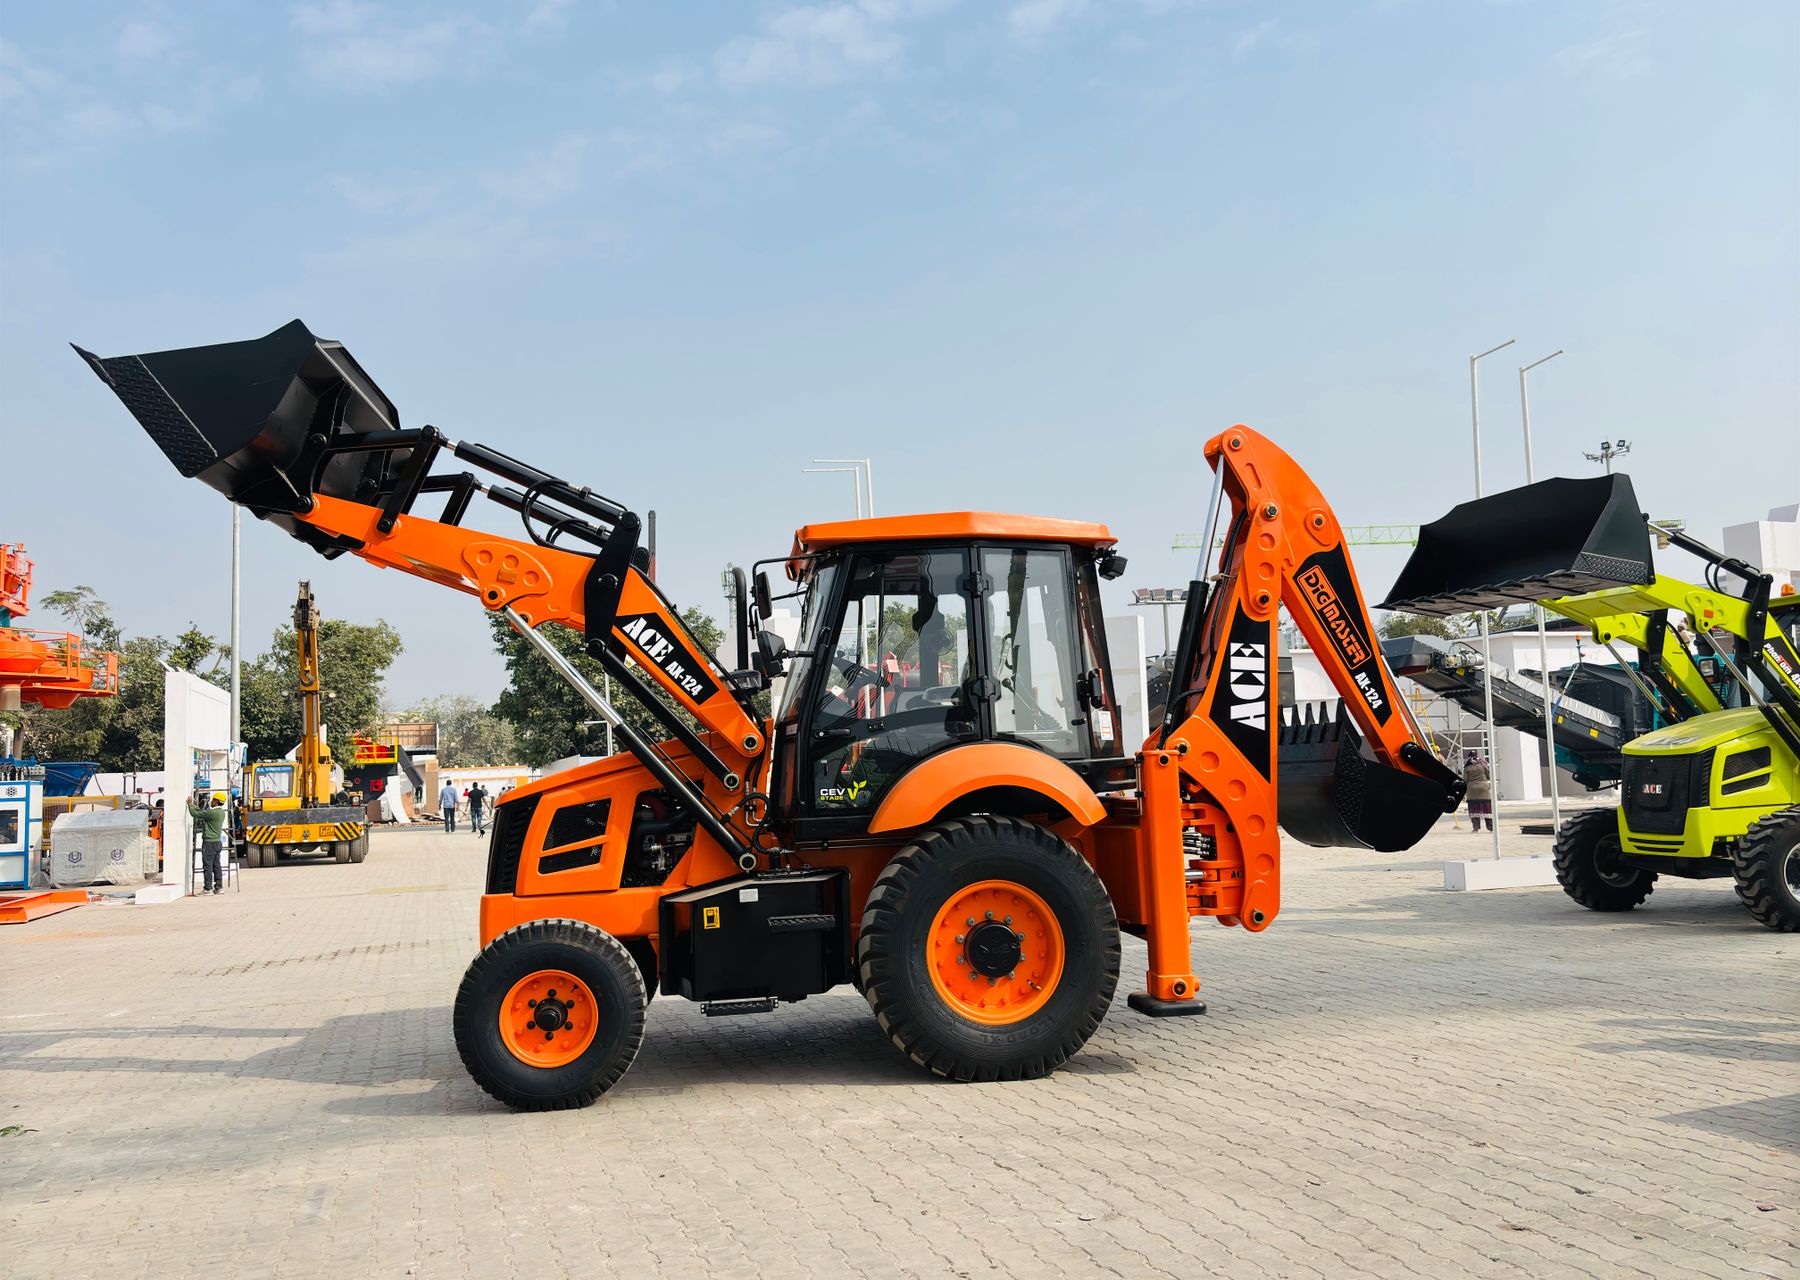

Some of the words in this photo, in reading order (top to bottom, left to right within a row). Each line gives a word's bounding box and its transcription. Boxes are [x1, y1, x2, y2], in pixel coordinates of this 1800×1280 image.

[622, 617, 674, 663] ACE
[665, 661, 703, 696] AX-124
[1230, 642, 1265, 731] ACE
[1354, 671, 1383, 710] AX-124
[820, 788, 845, 796] CEV
[1642, 784, 1662, 794] ACE
